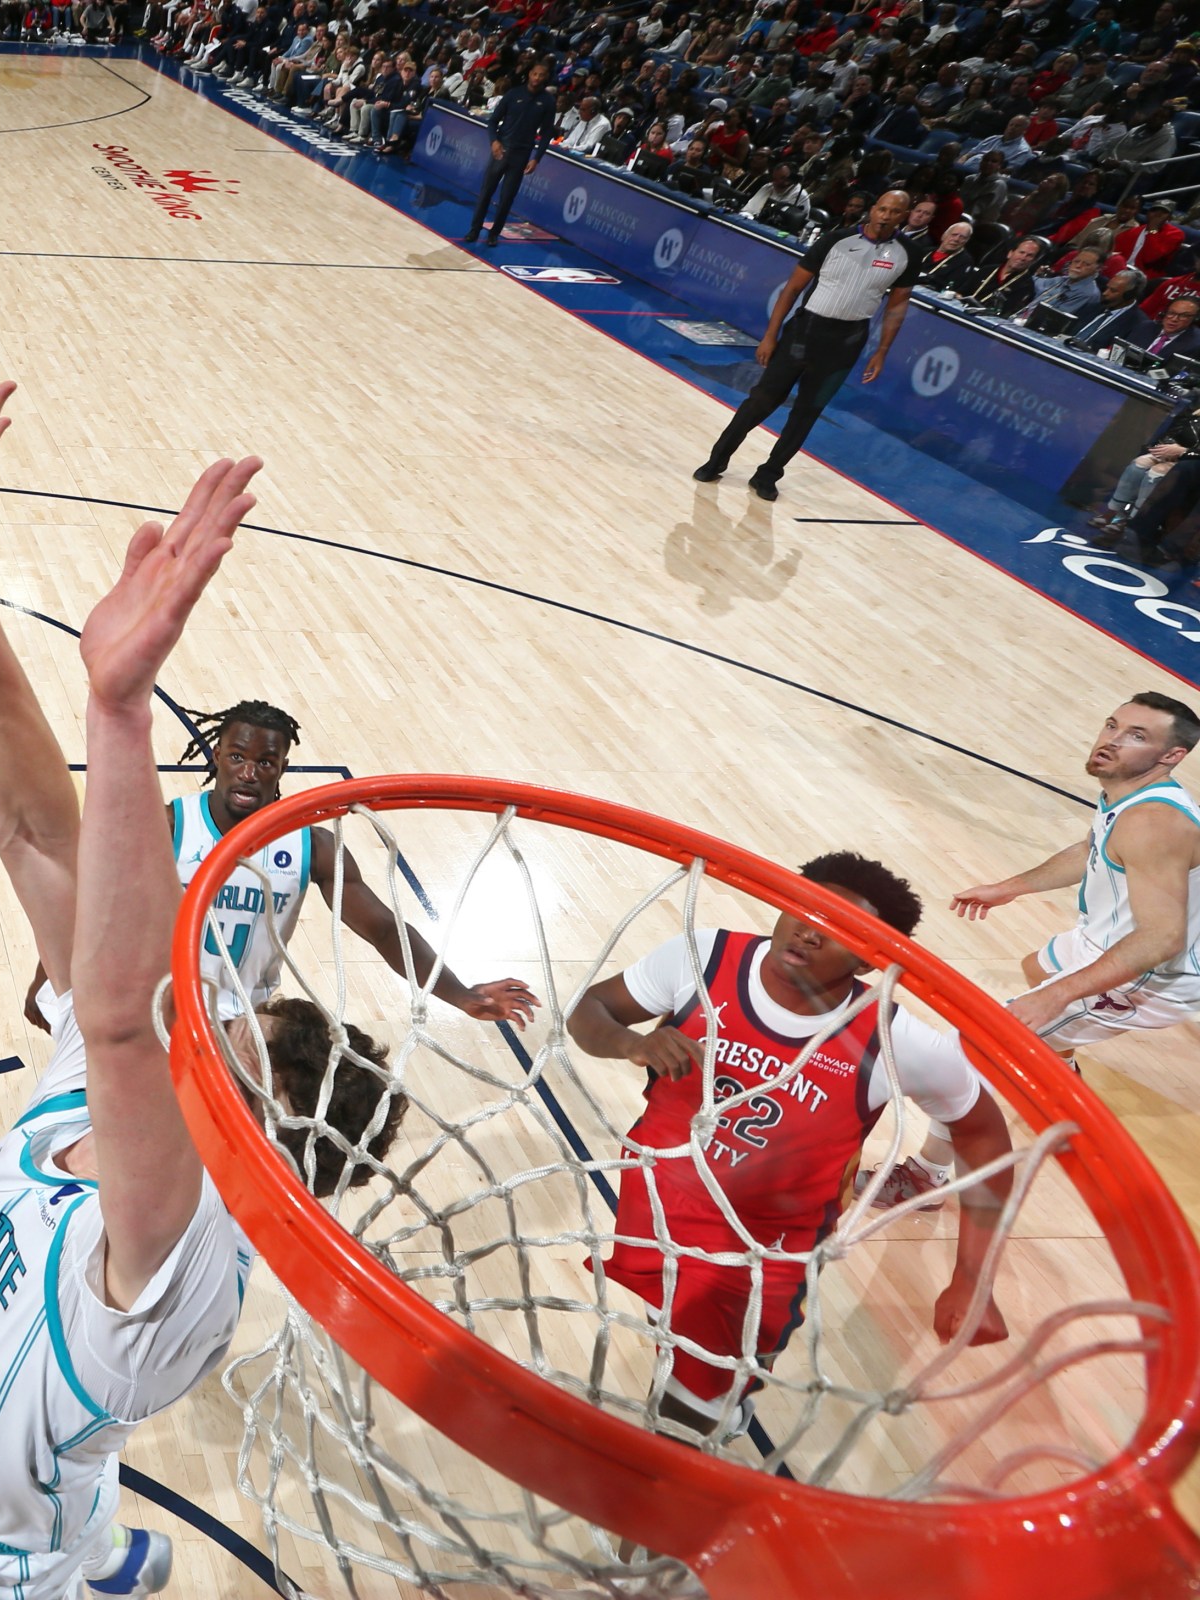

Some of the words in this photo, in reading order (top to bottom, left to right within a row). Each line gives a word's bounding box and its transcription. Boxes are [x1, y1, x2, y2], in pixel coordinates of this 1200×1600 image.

[277, 124, 360, 156] Health
[91, 166, 127, 191] CENTER
[92, 143, 168, 190] SMOOTHIE
[688, 242, 749, 280] HANCOCK
[967, 368, 1070, 425] HANCOCK
[808, 1058, 848, 1078] PRODUCTS
[702, 1134, 749, 1168] ITY
